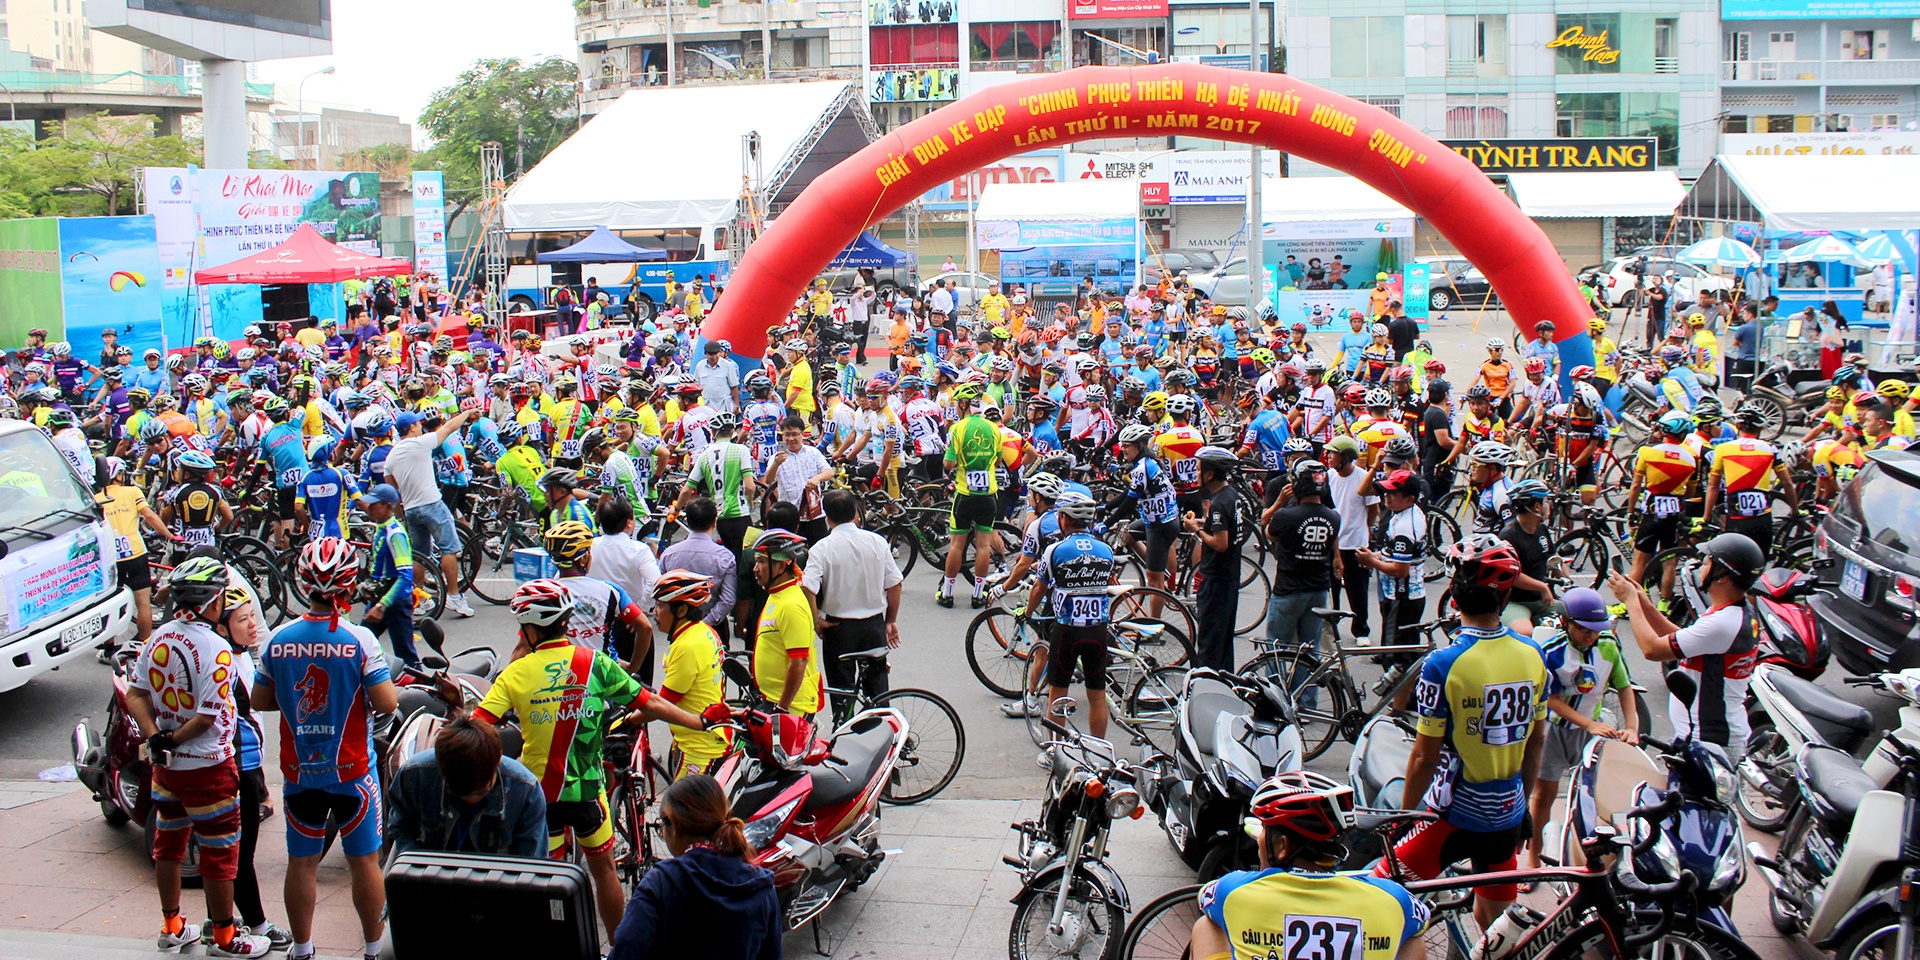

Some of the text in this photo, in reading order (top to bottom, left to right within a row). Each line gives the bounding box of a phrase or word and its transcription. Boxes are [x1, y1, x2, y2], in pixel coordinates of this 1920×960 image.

[875, 152, 911, 187] GIẢI
[912, 134, 949, 166] ĐUA
[948, 119, 974, 146] XE
[973, 104, 1007, 133] ĐẠP
[1087, 82, 1131, 107] PHỤC
[1136, 76, 1184, 101] THIÊN
[1195, 81, 1218, 107] HẠ
[1227, 82, 1251, 112] ĐỆ
[1255, 88, 1302, 117] NHẤT
[1013, 125, 1057, 147] LẦN
[1064, 111, 1109, 135] THỨ
[1113, 115, 1127, 130] II
[1146, 110, 1199, 128] NĂM
[1205, 115, 1262, 135] 2017
[1453, 140, 1649, 168] UỲNH TRANG
[243, 174, 277, 199] Khai
[1191, 175, 1243, 186] MAI ANH
[1144, 187, 1162, 196] HUY
[1374, 222, 1391, 233] 4G
[482, 440, 500, 456] 163
[562, 441, 578, 453] 342
[1177, 459, 1197, 474] 022
[283, 468, 302, 483] 337
[967, 472, 988, 486] 121
[1142, 499, 1165, 515] 348
[1740, 495, 1763, 509] 021
[309, 522, 323, 537] 097
[1073, 599, 1100, 618] 349
[270, 642, 359, 659] DANANG
[551, 694, 577, 705] bicycle
[1485, 684, 1531, 727] 238
[530, 707, 553, 725] ĐÀ
[296, 724, 335, 736] AZANH
[1242, 928, 1261, 945] CÂU
[1368, 936, 1391, 951] THAO
[1288, 919, 1358, 960] 237
